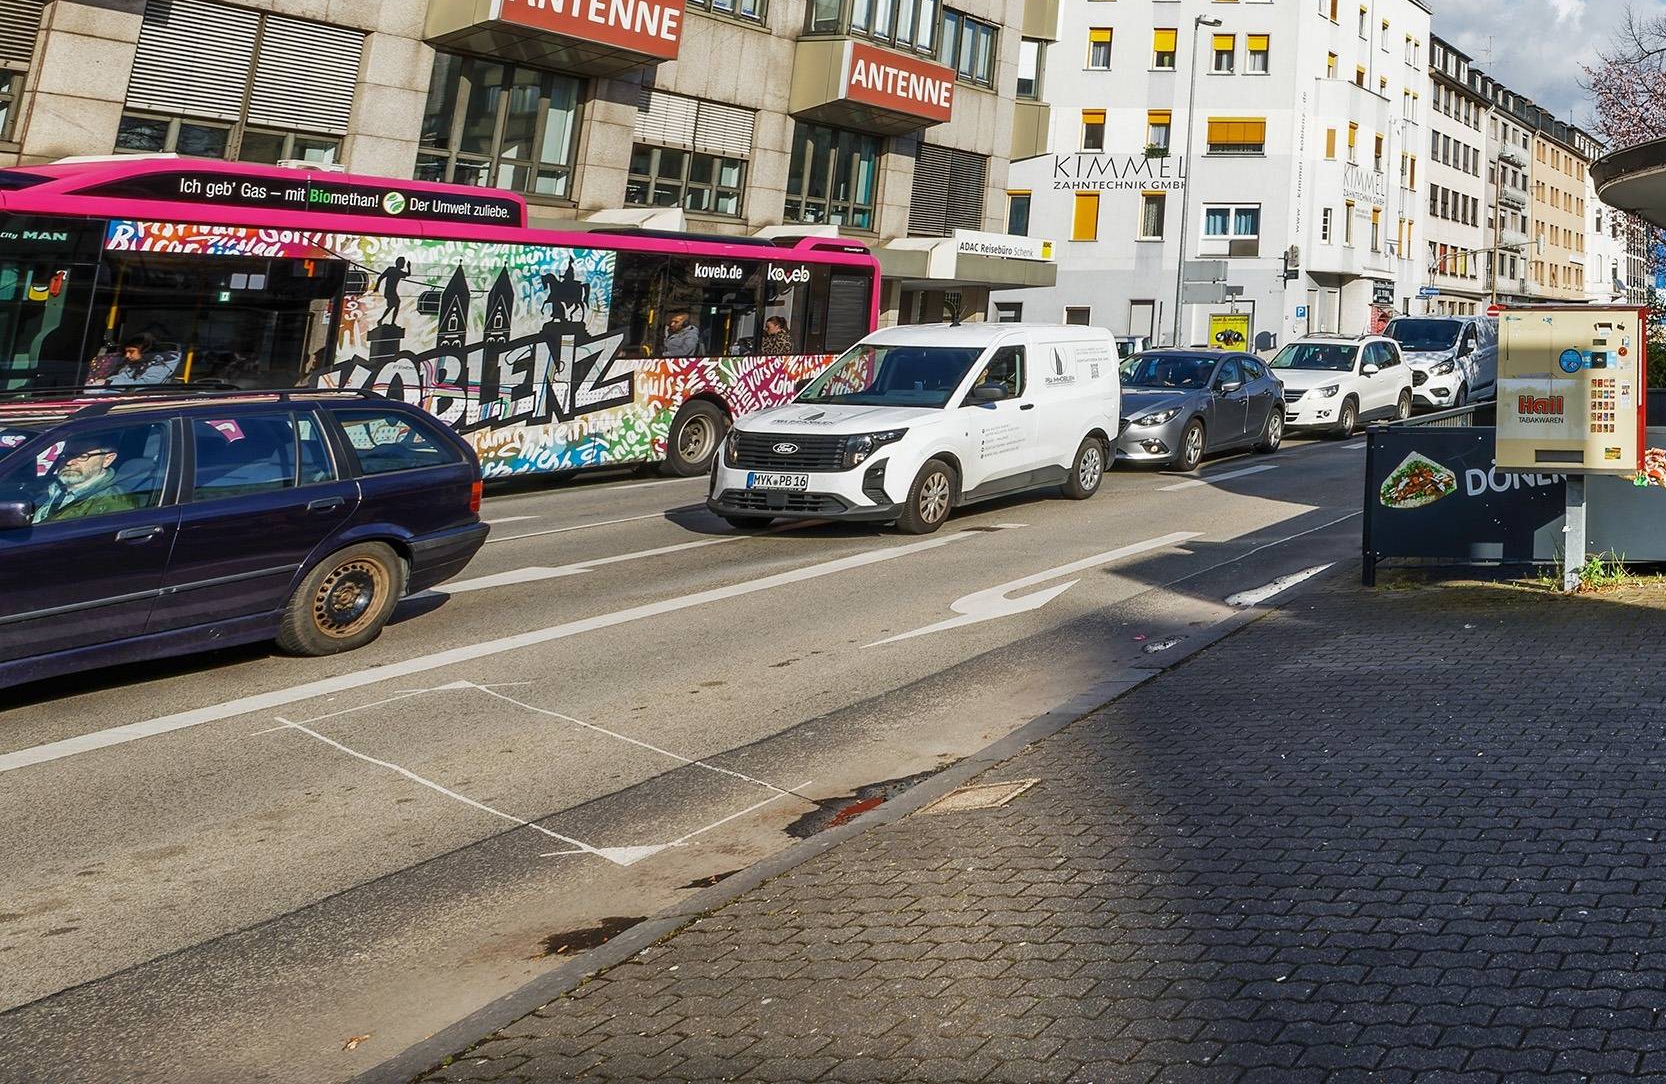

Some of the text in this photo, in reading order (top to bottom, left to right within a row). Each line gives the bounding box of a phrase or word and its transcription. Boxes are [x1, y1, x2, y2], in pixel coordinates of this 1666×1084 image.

[850, 58, 952, 108] ANTENNE
[1053, 155, 1187, 179] KIMMEL
[1053, 180, 1147, 190] ZAHNTECHNIK
[1343, 163, 1385, 197] KIMMEL
[179, 178, 201, 194] Ich
[206, 181, 236, 198] geb'
[241, 182, 267, 199] Gas
[285, 188, 306, 202] mit
[309, 188, 379, 208] Biomethan!
[409, 197, 510, 218] Der Umwelt zuliebe.
[22, 231, 68, 241] MAN
[960, 241, 1034, 258] ADAC Reisebüro Schenk
[694, 262, 743, 280] koveb.de
[767, 262, 811, 284] koveb
[1297, 307, 1304, 317] P
[1518, 395, 1564, 415] Hall
[1518, 416, 1564, 424] TABAKWAREN
[777, 443, 793, 453] Ford
[753, 474, 806, 487] MYK PB 16
